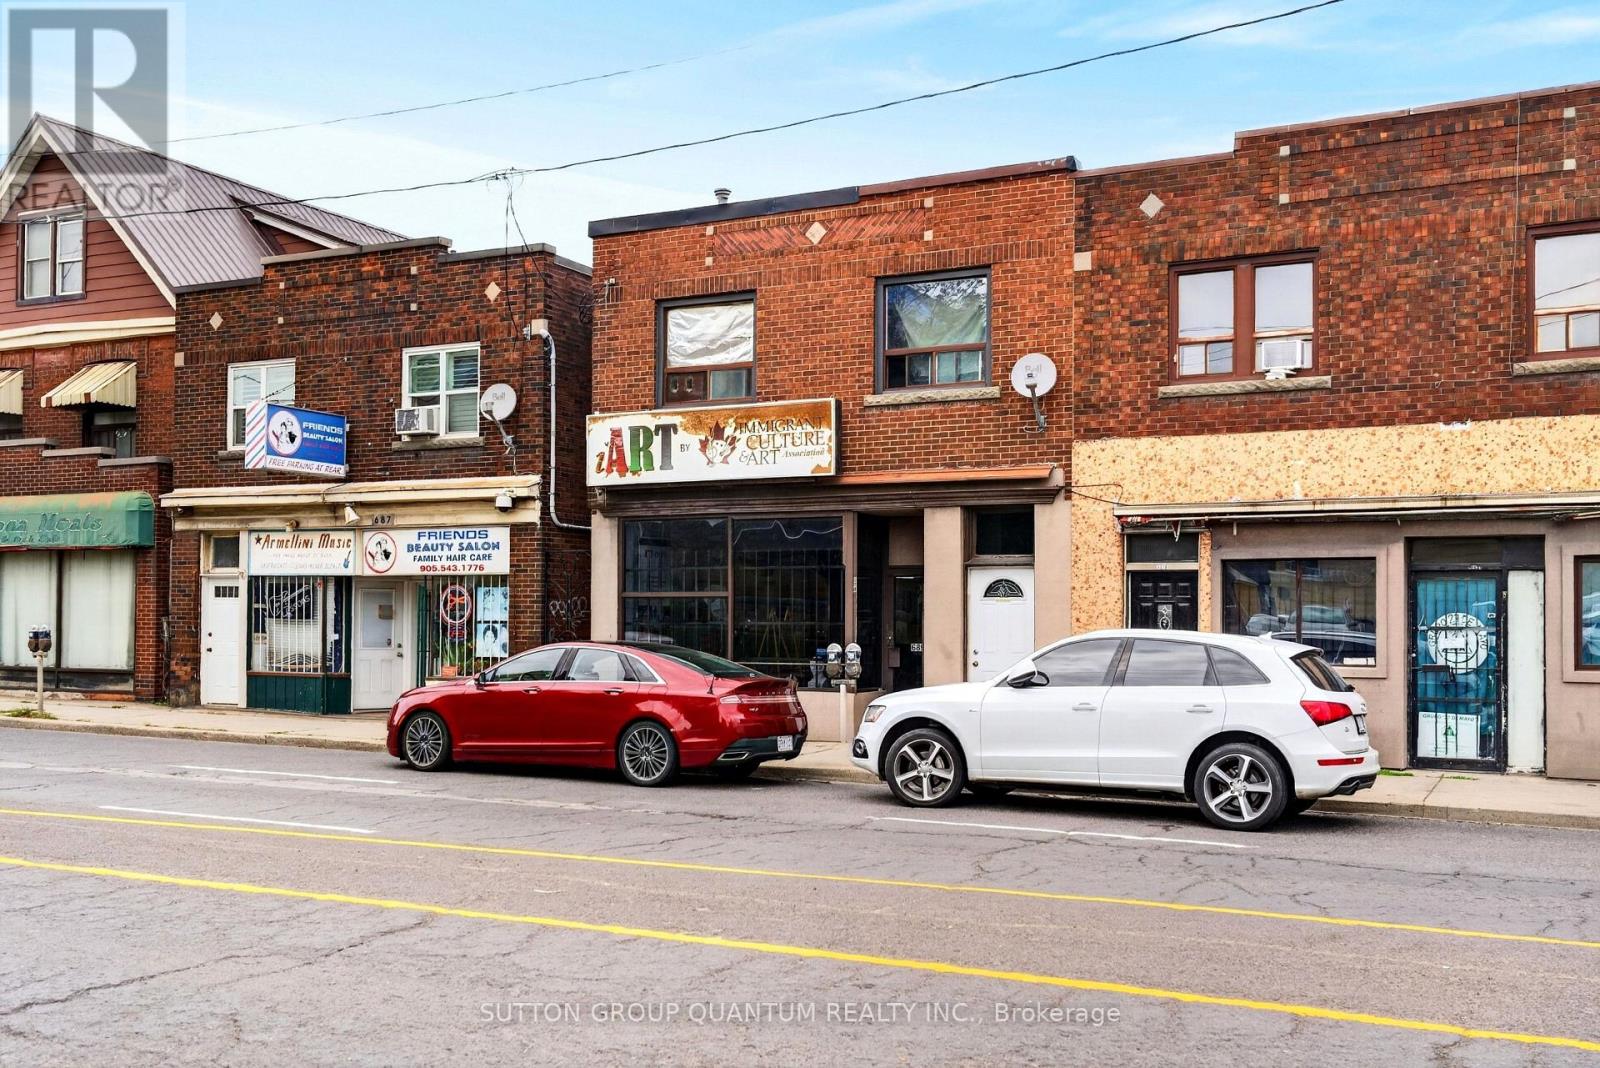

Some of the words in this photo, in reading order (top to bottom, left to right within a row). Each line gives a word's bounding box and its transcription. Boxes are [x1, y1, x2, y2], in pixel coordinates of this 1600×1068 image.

[303, 421, 344, 435] FRIENDS
[739, 416, 825, 434] IMMIGRANT
[746, 430, 826, 450] CULTURE
[680, 443, 690, 453] BY
[268, 457, 286, 467] FREE
[287, 460, 314, 471] PARKING
[315, 463, 323, 472] AT
[324, 465, 342, 475] REAR
[318, 533, 352, 549] Music
[417, 530, 489, 540] FRIENDS
[406, 542, 453, 552] BEAUTY
[457, 541, 500, 552] SALON
[446, 554, 466, 562] HAIR
[469, 553, 493, 561] CARE
[419, 564, 485, 572] 905.543.1776
